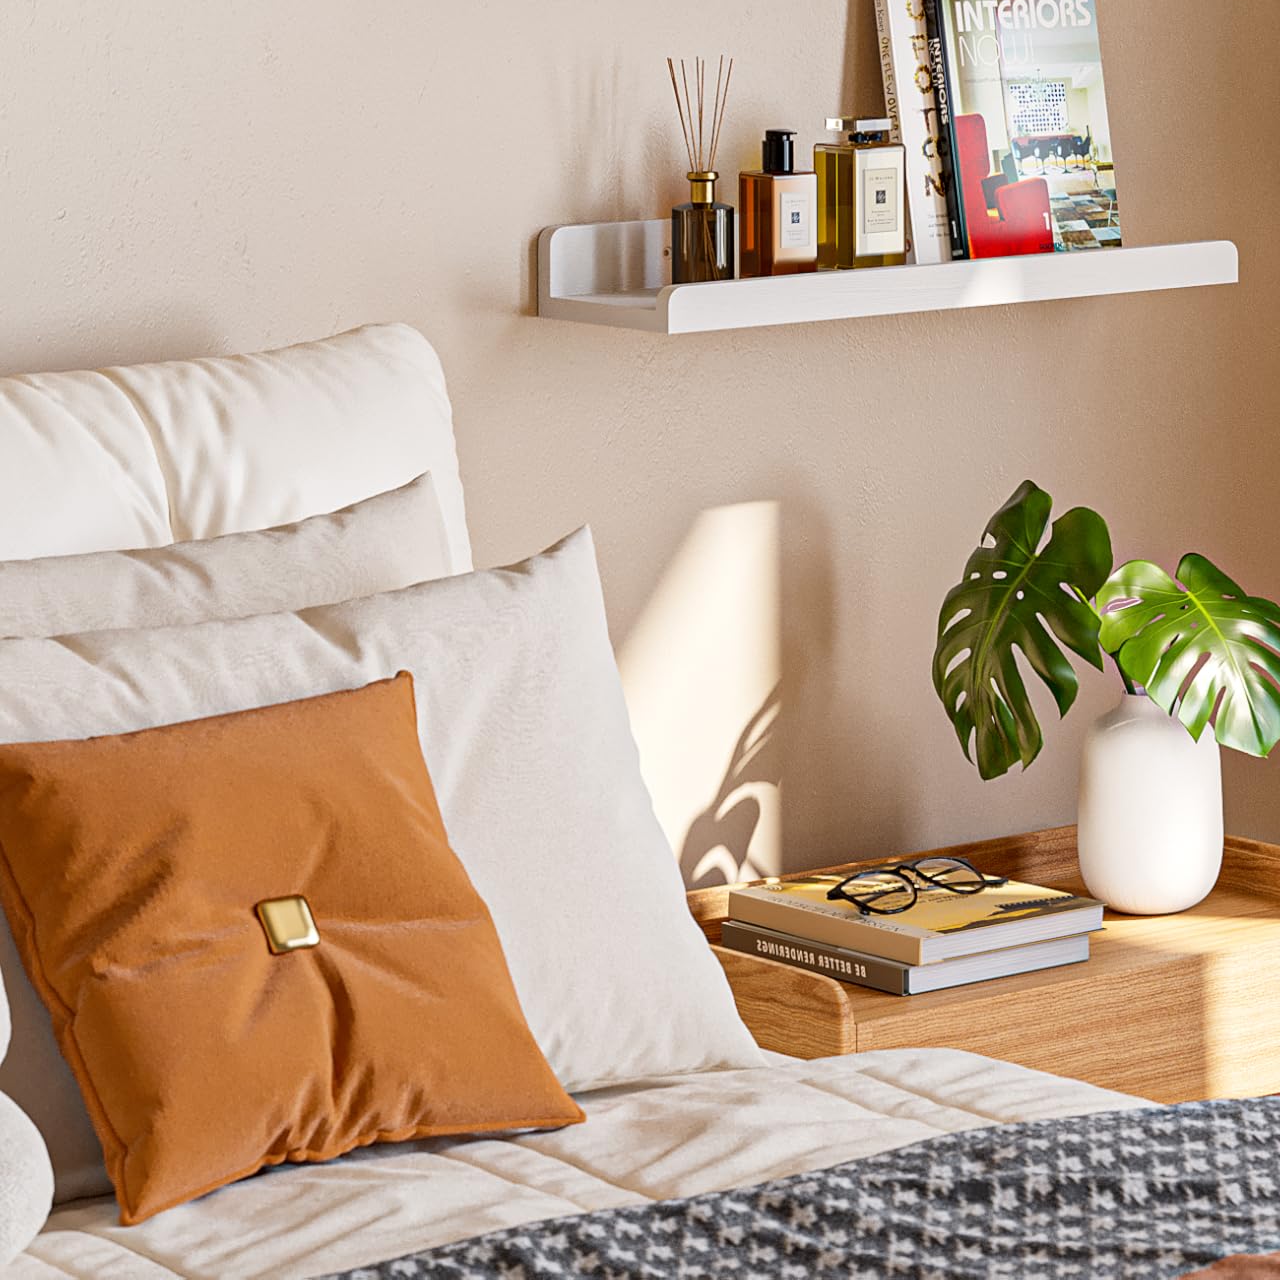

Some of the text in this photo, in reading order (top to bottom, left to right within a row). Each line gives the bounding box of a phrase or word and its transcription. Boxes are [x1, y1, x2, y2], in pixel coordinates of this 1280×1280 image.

[881, 36, 890, 61] ONE
[883, 62, 895, 95] FLEW
[933, 37, 949, 125] INTERIORS
[951, 220, 957, 238] 1
[1043, 212, 1050, 230] 1
